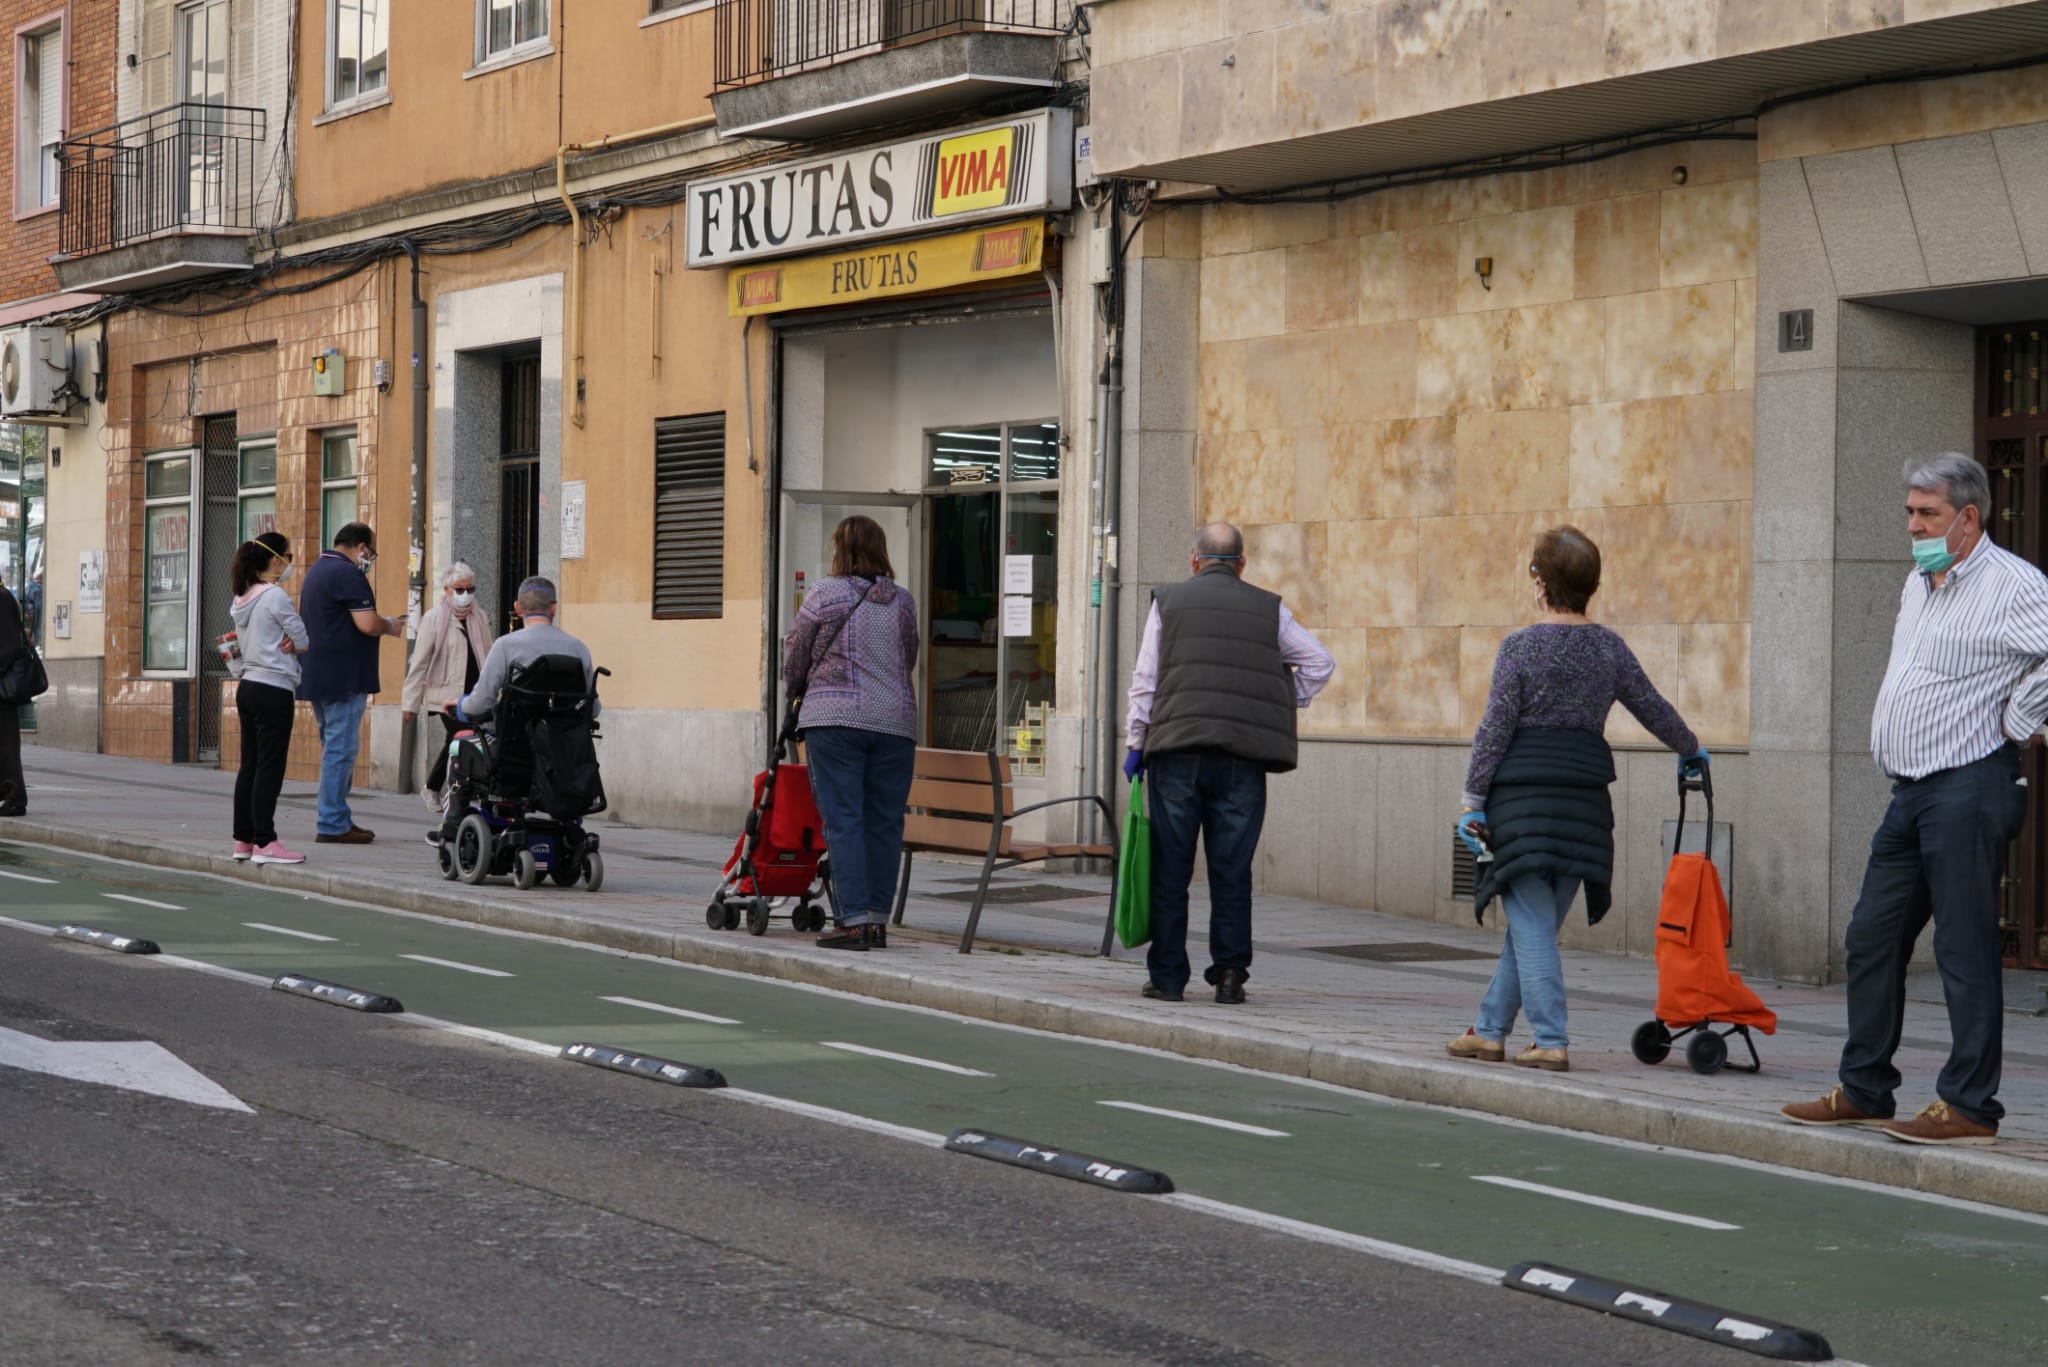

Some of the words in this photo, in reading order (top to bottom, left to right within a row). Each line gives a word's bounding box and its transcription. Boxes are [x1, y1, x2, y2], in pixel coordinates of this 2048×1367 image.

[698, 150, 893, 258] FRUTAS
[941, 145, 1006, 199] VIMA
[744, 277, 775, 299] VIMA
[832, 250, 917, 294] FRUTAS
[985, 237, 1019, 261] VIMA
